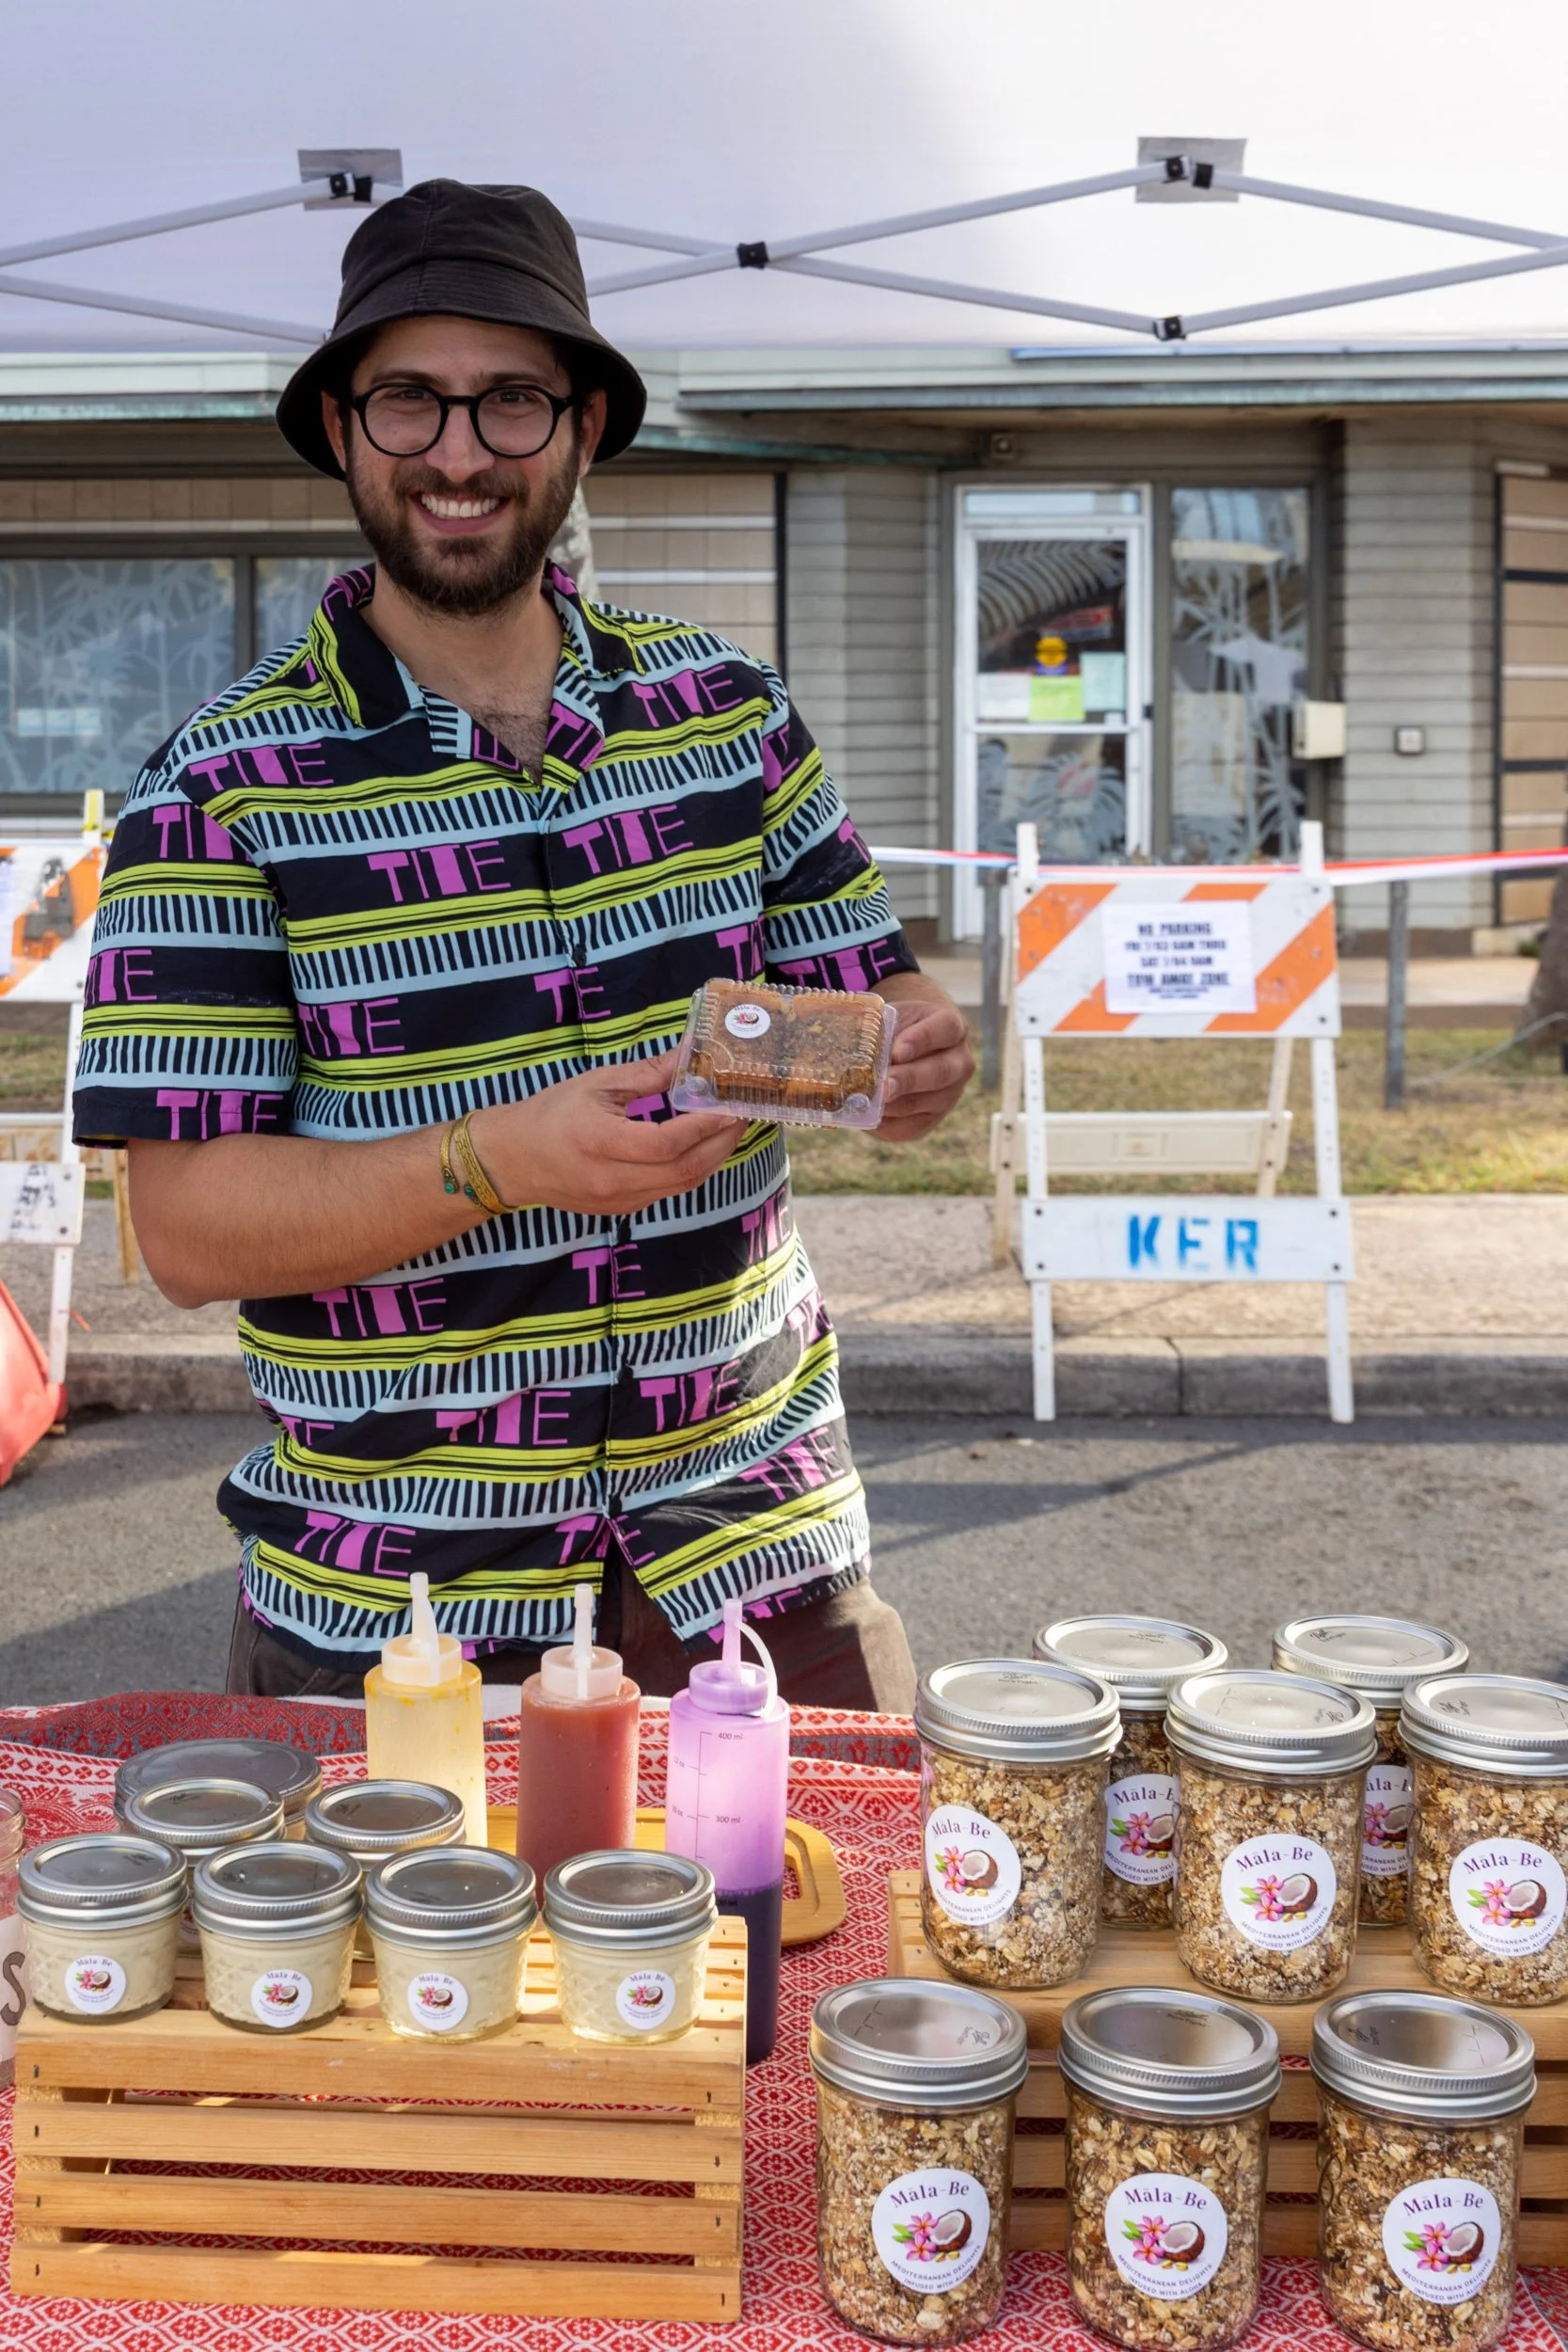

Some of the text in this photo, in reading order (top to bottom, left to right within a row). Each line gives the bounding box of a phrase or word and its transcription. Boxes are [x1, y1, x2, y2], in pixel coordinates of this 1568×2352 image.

[716, 1816, 729, 1824] 300
[891, 2260, 952, 2281] MEDITERRANEAN
[937, 2280, 954, 2289] WITH
